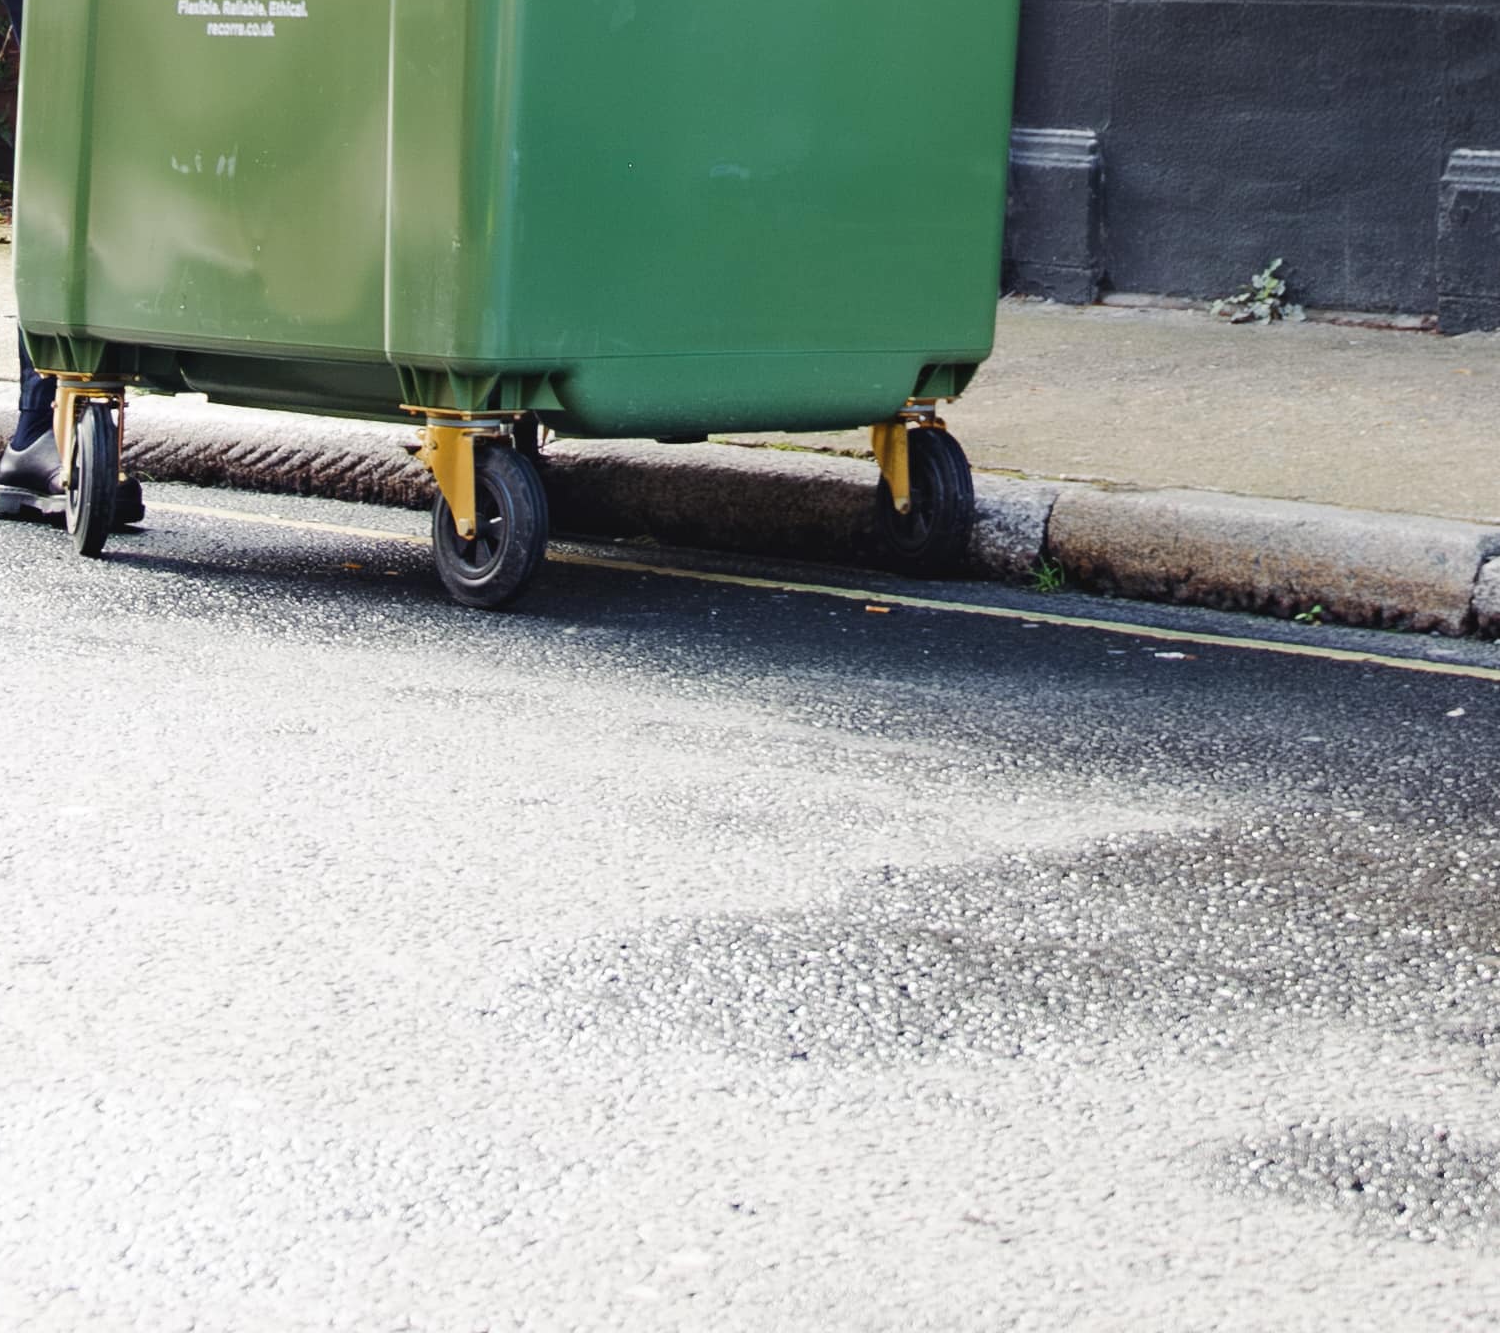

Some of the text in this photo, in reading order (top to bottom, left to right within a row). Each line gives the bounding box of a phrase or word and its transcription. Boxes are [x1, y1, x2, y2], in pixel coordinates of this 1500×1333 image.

[222, 0, 268, 17] Reliable.
[269, 0, 309, 18] Ethical.
[206, 21, 276, 37] recorra.co.uk
